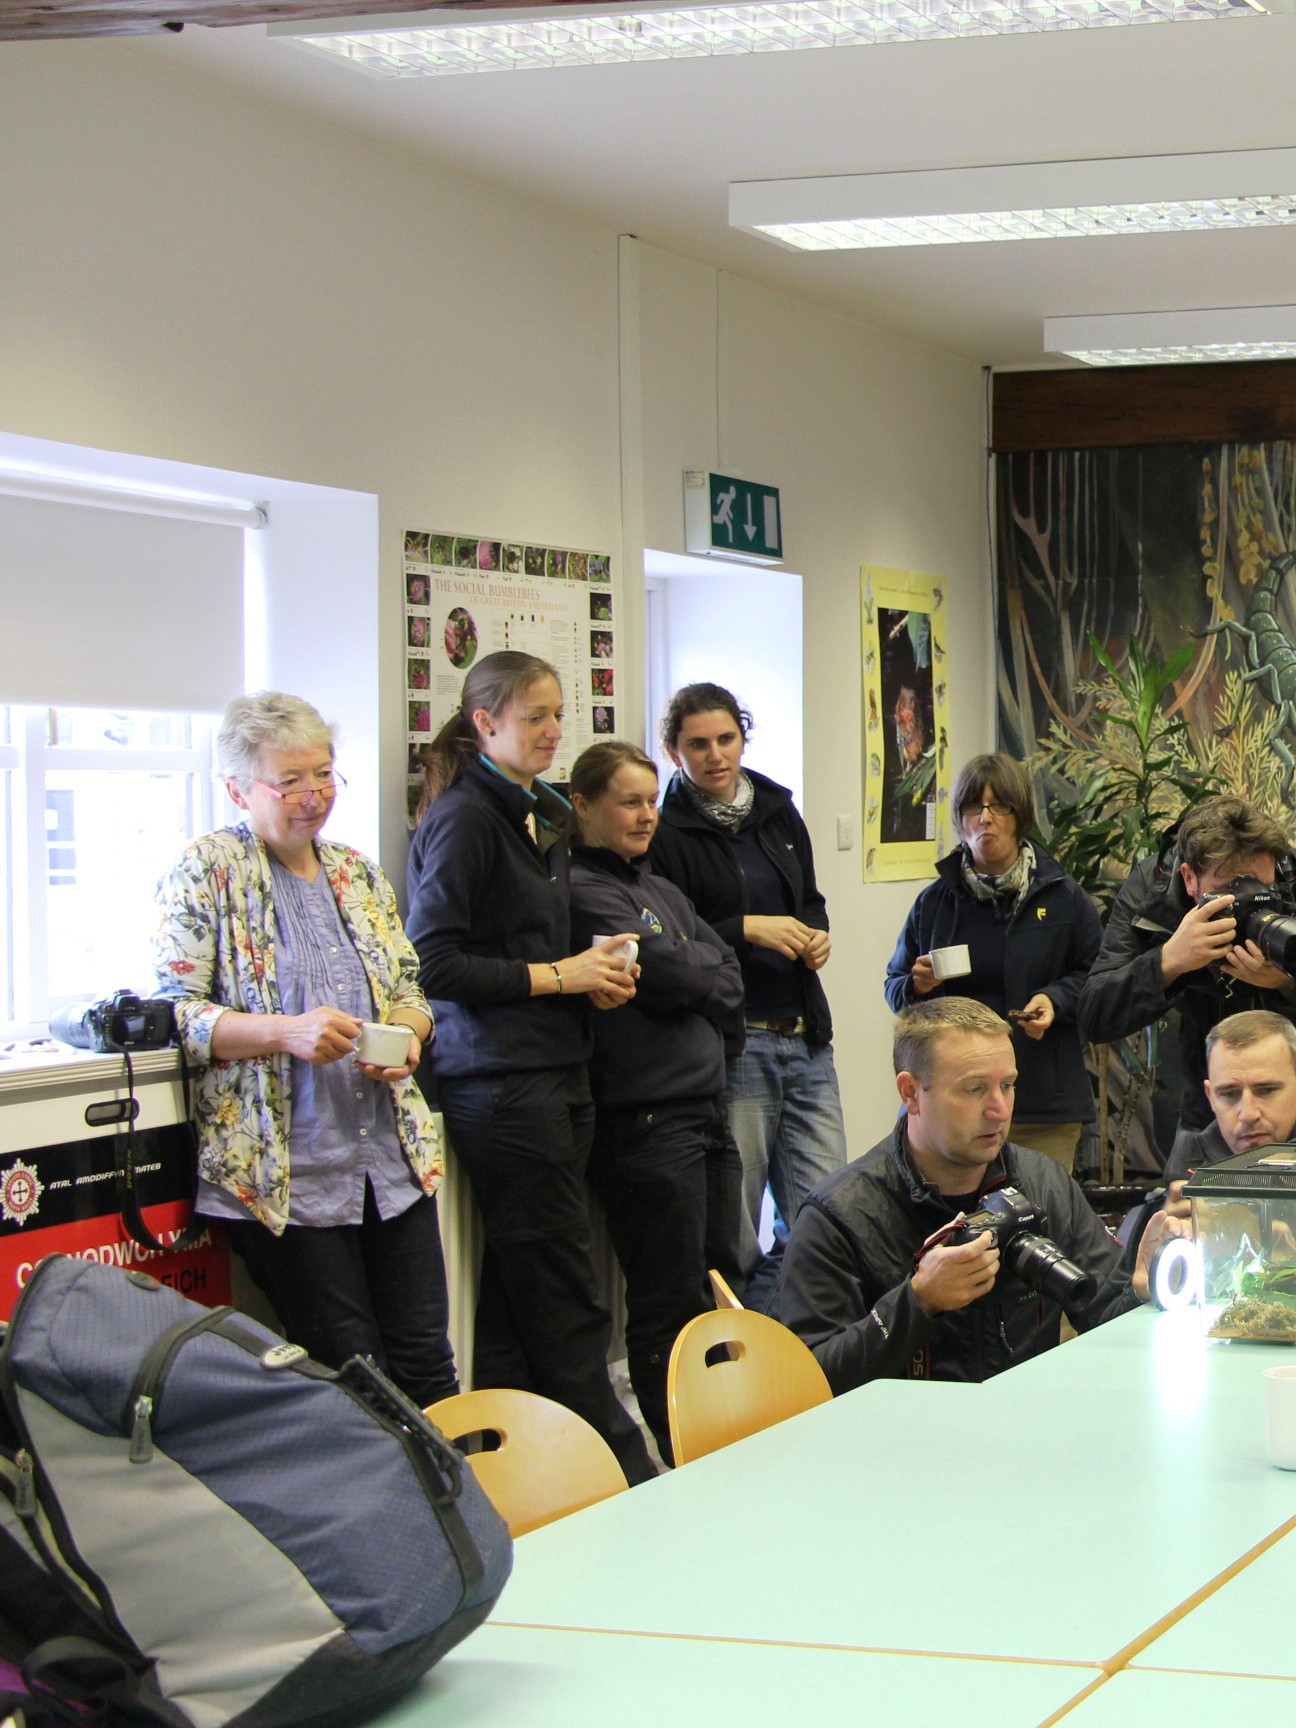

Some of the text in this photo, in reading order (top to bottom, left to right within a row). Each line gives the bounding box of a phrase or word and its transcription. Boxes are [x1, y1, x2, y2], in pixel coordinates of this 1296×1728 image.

[434, 579, 540, 600] THE SOCIAL BUMBLEBEES
[50, 1180, 72, 1190] ATAL
[75, 1169, 125, 1185] AMDDIFFYN
[1018, 1214, 1035, 1222] Canon
